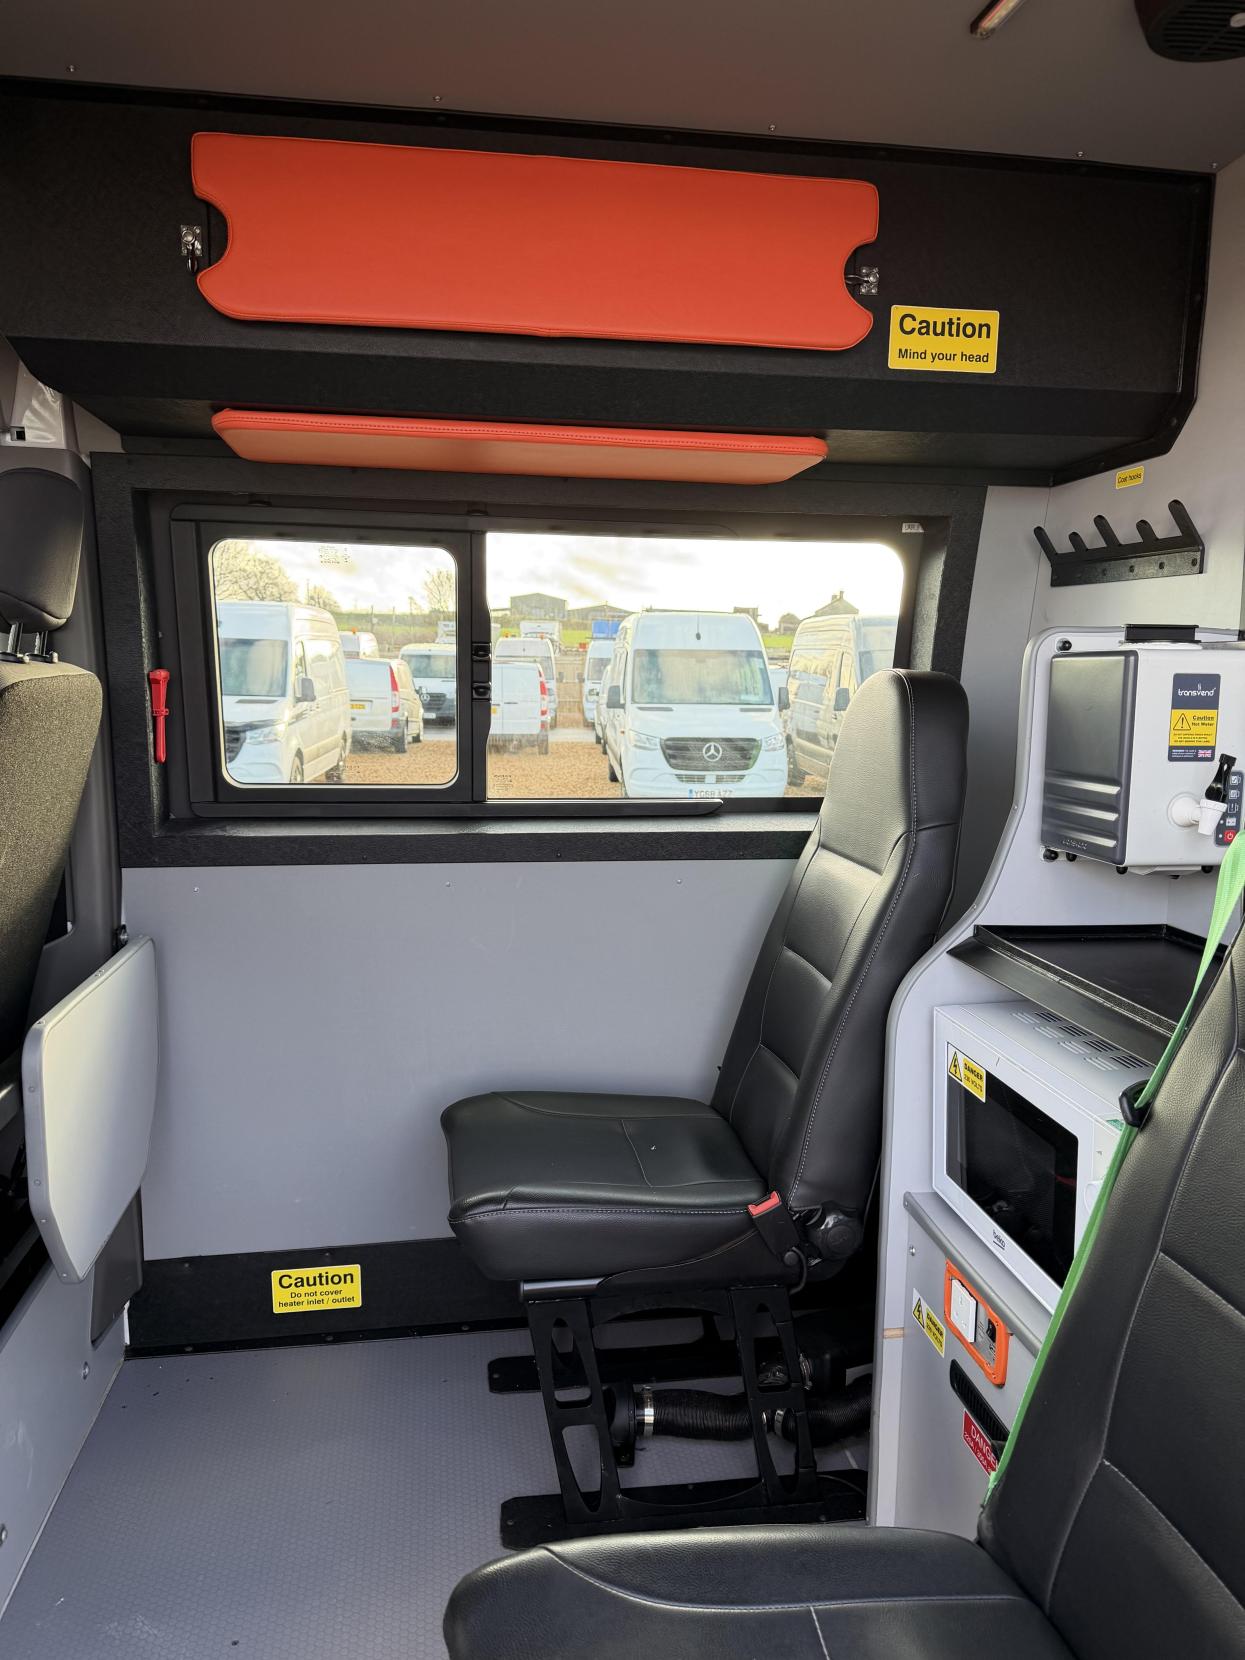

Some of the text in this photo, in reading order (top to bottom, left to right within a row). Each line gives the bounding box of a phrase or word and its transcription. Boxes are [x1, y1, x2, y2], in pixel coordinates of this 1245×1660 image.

[899, 314, 991, 339] Caution
[898, 348, 989, 363] Mind your head
[1178, 687, 1215, 697] transvend
[964, 1062, 983, 1081] DANGER
[971, 1078, 983, 1093] VOLTS
[278, 1272, 354, 1289] Caution
[290, 1289, 343, 1299] Do not cover
[926, 1311, 944, 1338] DANGER
[971, 1424, 997, 1469] DANGE
